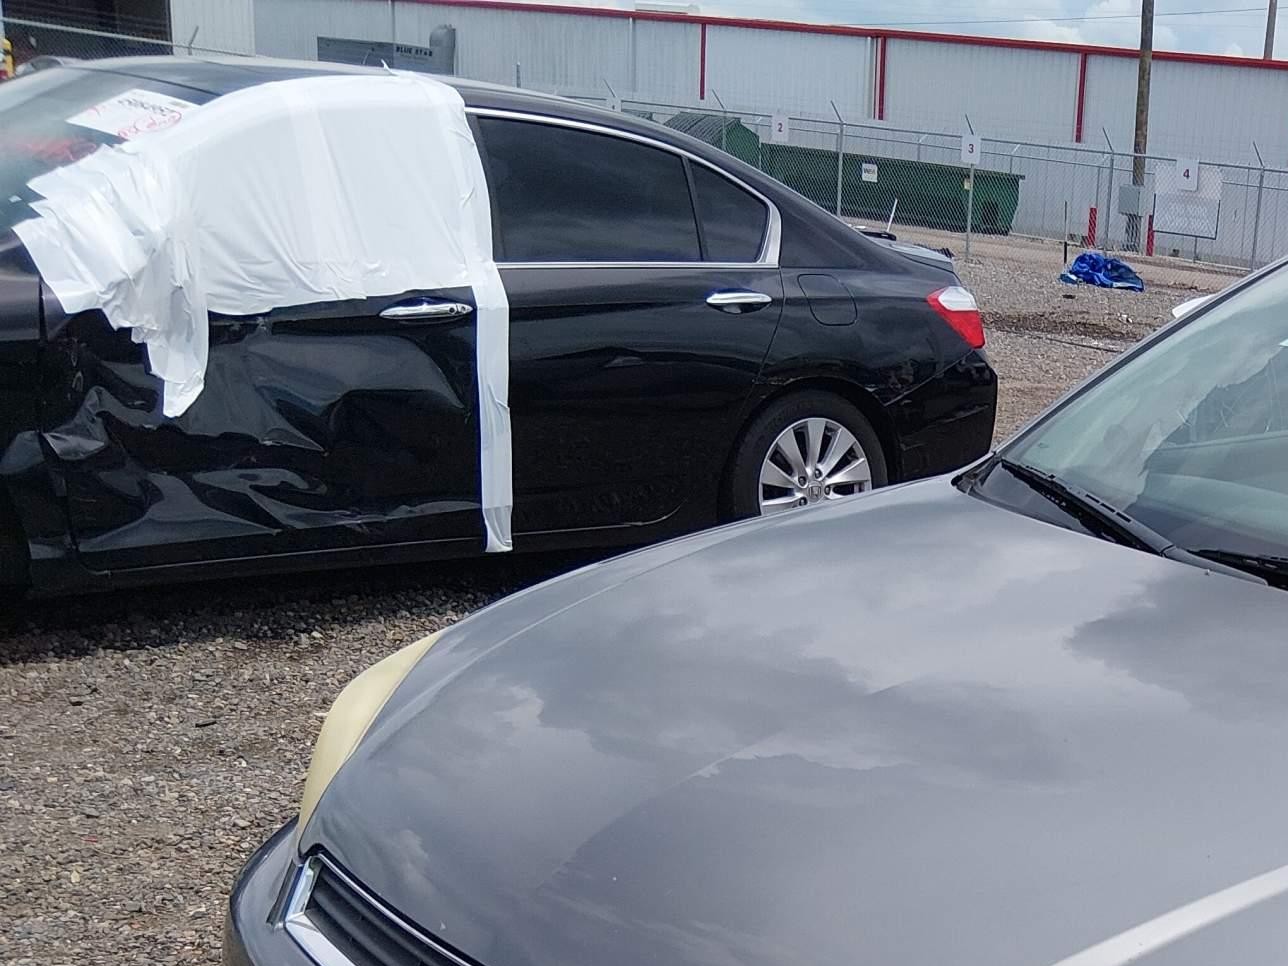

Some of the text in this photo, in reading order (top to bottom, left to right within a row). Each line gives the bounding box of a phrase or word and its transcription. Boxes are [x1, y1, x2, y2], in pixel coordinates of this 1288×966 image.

[777, 122, 784, 132] 2
[967, 143, 975, 154] 3
[1182, 168, 1191, 180] 4
